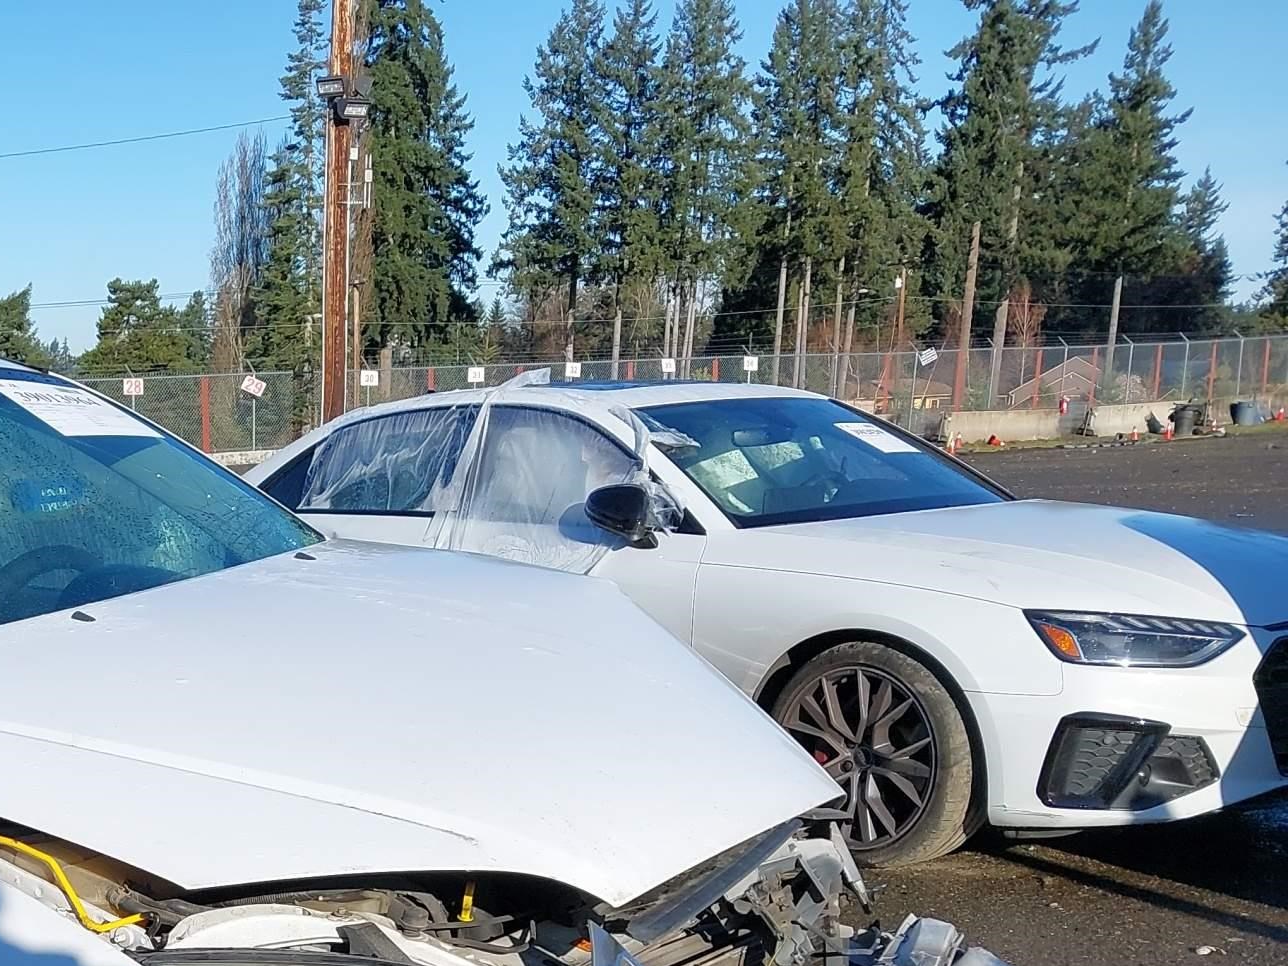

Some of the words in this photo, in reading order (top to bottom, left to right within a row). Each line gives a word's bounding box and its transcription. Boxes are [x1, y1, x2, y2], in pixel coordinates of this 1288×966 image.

[126, 380, 142, 394] 28
[244, 378, 263, 394] 29
[14, 391, 101, 406] 39013964
